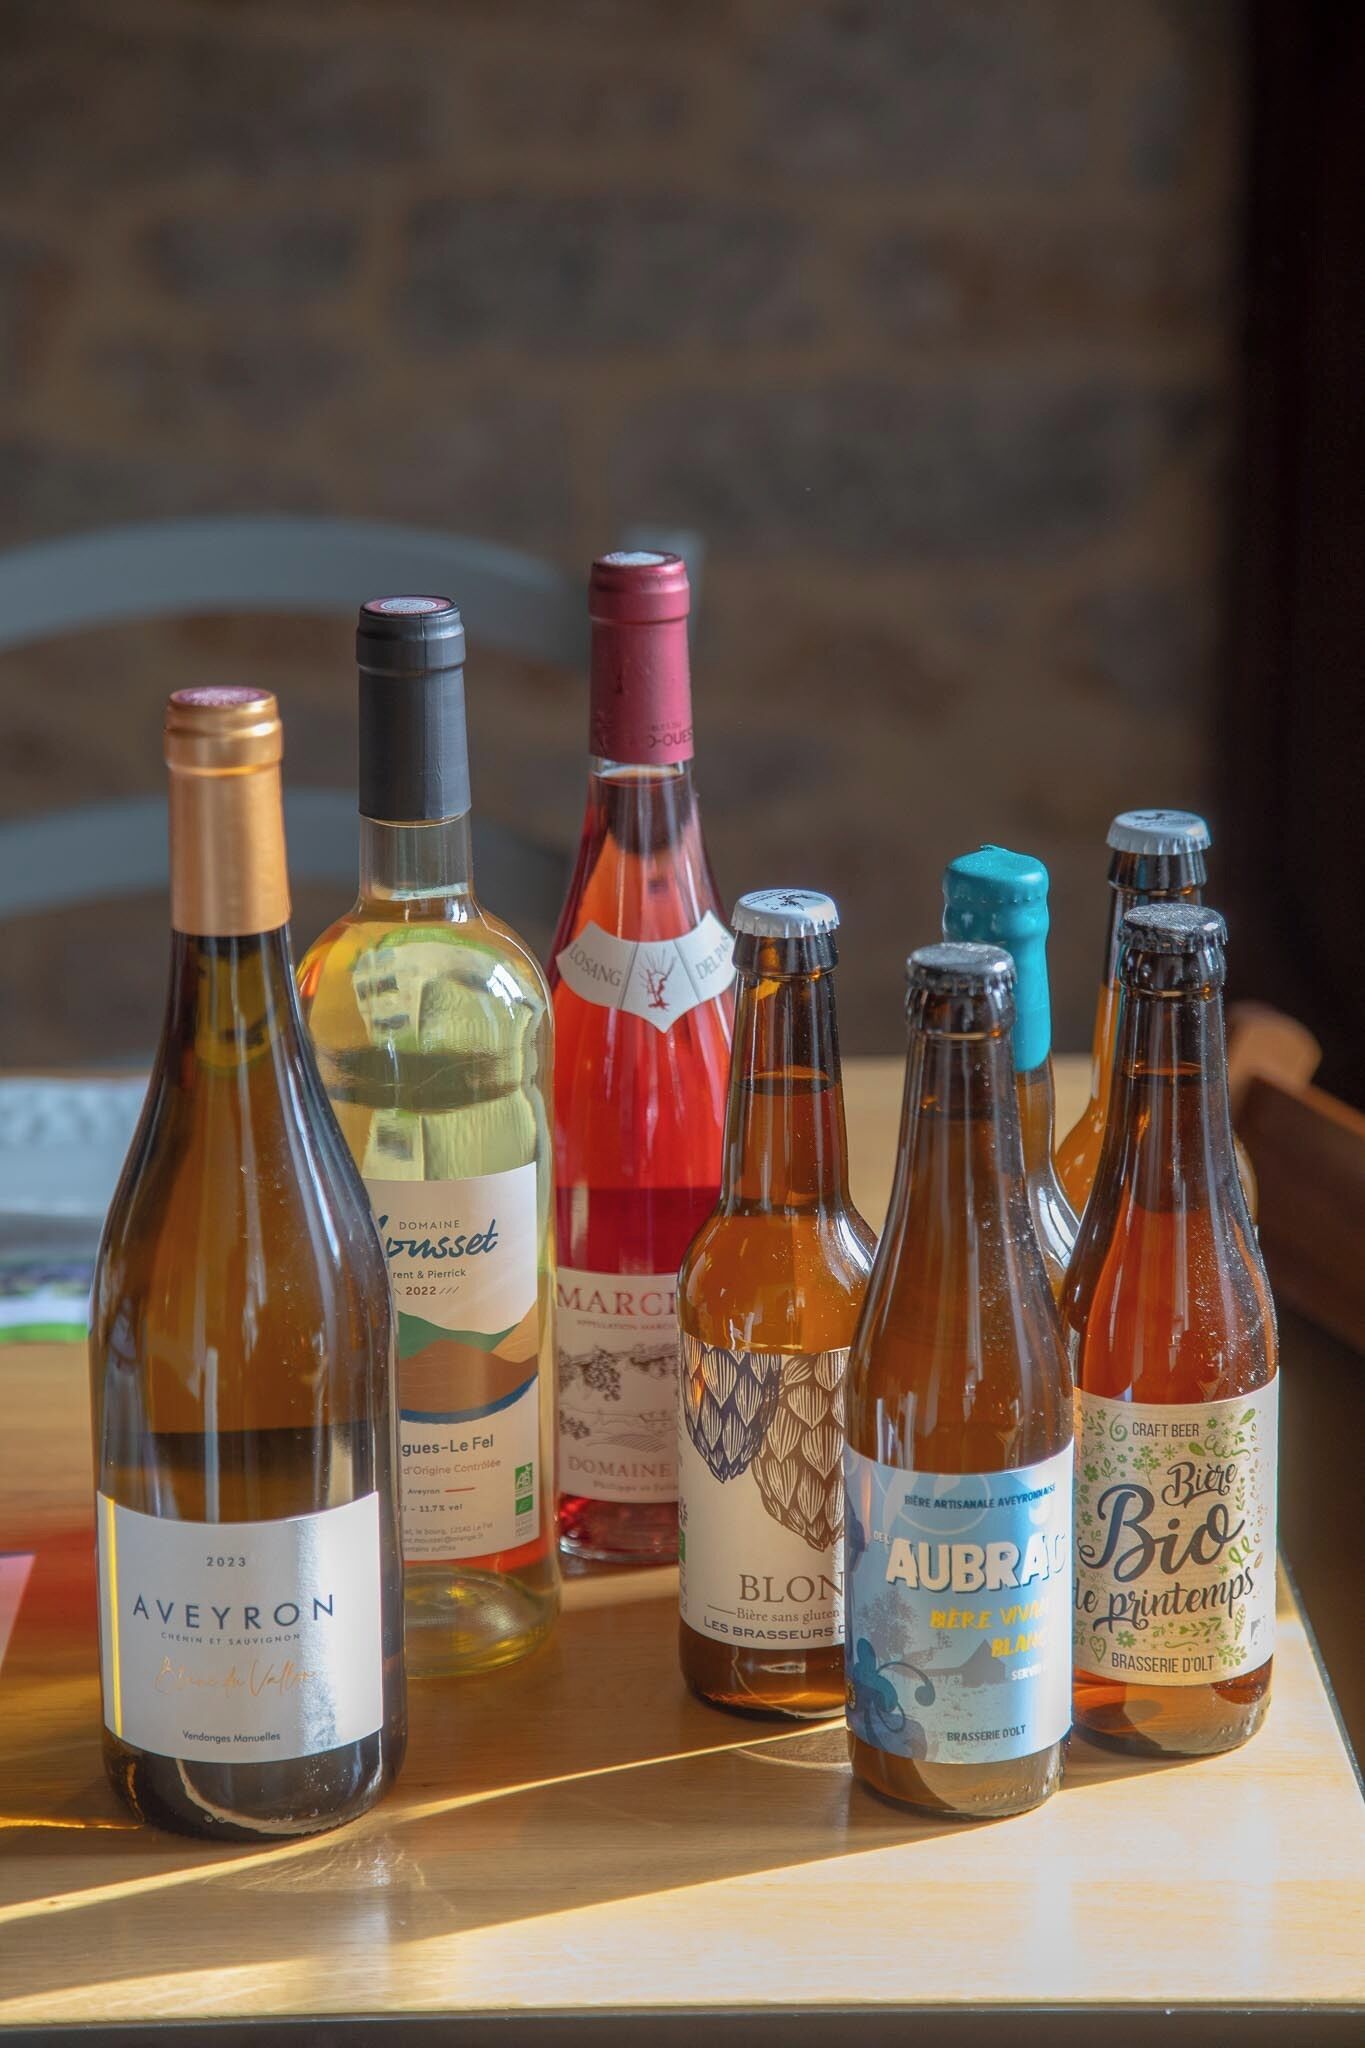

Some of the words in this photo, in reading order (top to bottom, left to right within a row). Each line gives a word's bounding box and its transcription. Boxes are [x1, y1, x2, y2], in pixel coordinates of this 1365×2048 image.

[399, 1219, 461, 1231] DOMAINE
[378, 1214, 499, 1260] ousset
[392, 1271, 414, 1279] rent
[417, 1270, 424, 1279] &
[428, 1268, 466, 1279] Pierrick
[406, 1286, 436, 1296] 2022
[556, 1283, 677, 1316] MARCI
[1132, 1421, 1168, 1438] CRAFT
[1171, 1422, 1200, 1438] BEER
[400, 1439, 468, 1457] gues-Le
[472, 1434, 494, 1450] Fel
[403, 1466, 451, 1477] d'Origine
[454, 1459, 501, 1474] Contrôlée
[567, 1455, 673, 1478] DOMAINE
[407, 1488, 441, 1497] Aveyron
[1161, 1460, 1239, 1509] Bière
[449, 1503, 463, 1511] vol
[904, 1494, 932, 1508] BIÈRE
[933, 1498, 995, 1509] ARTISANALE
[1076, 1483, 1246, 1584] Bio
[206, 1556, 247, 1568] 2023
[739, 1571, 845, 1603] BLON
[1092, 1565, 1255, 1634] printemps
[132, 1593, 334, 1631] AVEYRON
[737, 1607, 768, 1622] Bière
[771, 1613, 799, 1622] sans
[802, 1609, 840, 1625] gluten
[929, 1607, 993, 1630] BIÈRE
[703, 1615, 729, 1634] LES
[733, 1626, 834, 1640] BRASSEURS
[160, 1632, 203, 1644] CHENIN
[209, 1638, 221, 1646] ET
[229, 1633, 302, 1646] SAUVIGNON
[1111, 1651, 1178, 1674] BRASSERIE
[1183, 1654, 1215, 1672] D'OLT
[182, 1729, 231, 1744] Vendanges
[234, 1731, 281, 1742] Manuelles
[946, 1731, 1001, 1742] BRASSERIE
[1002, 1724, 1026, 1738] D'OLT
